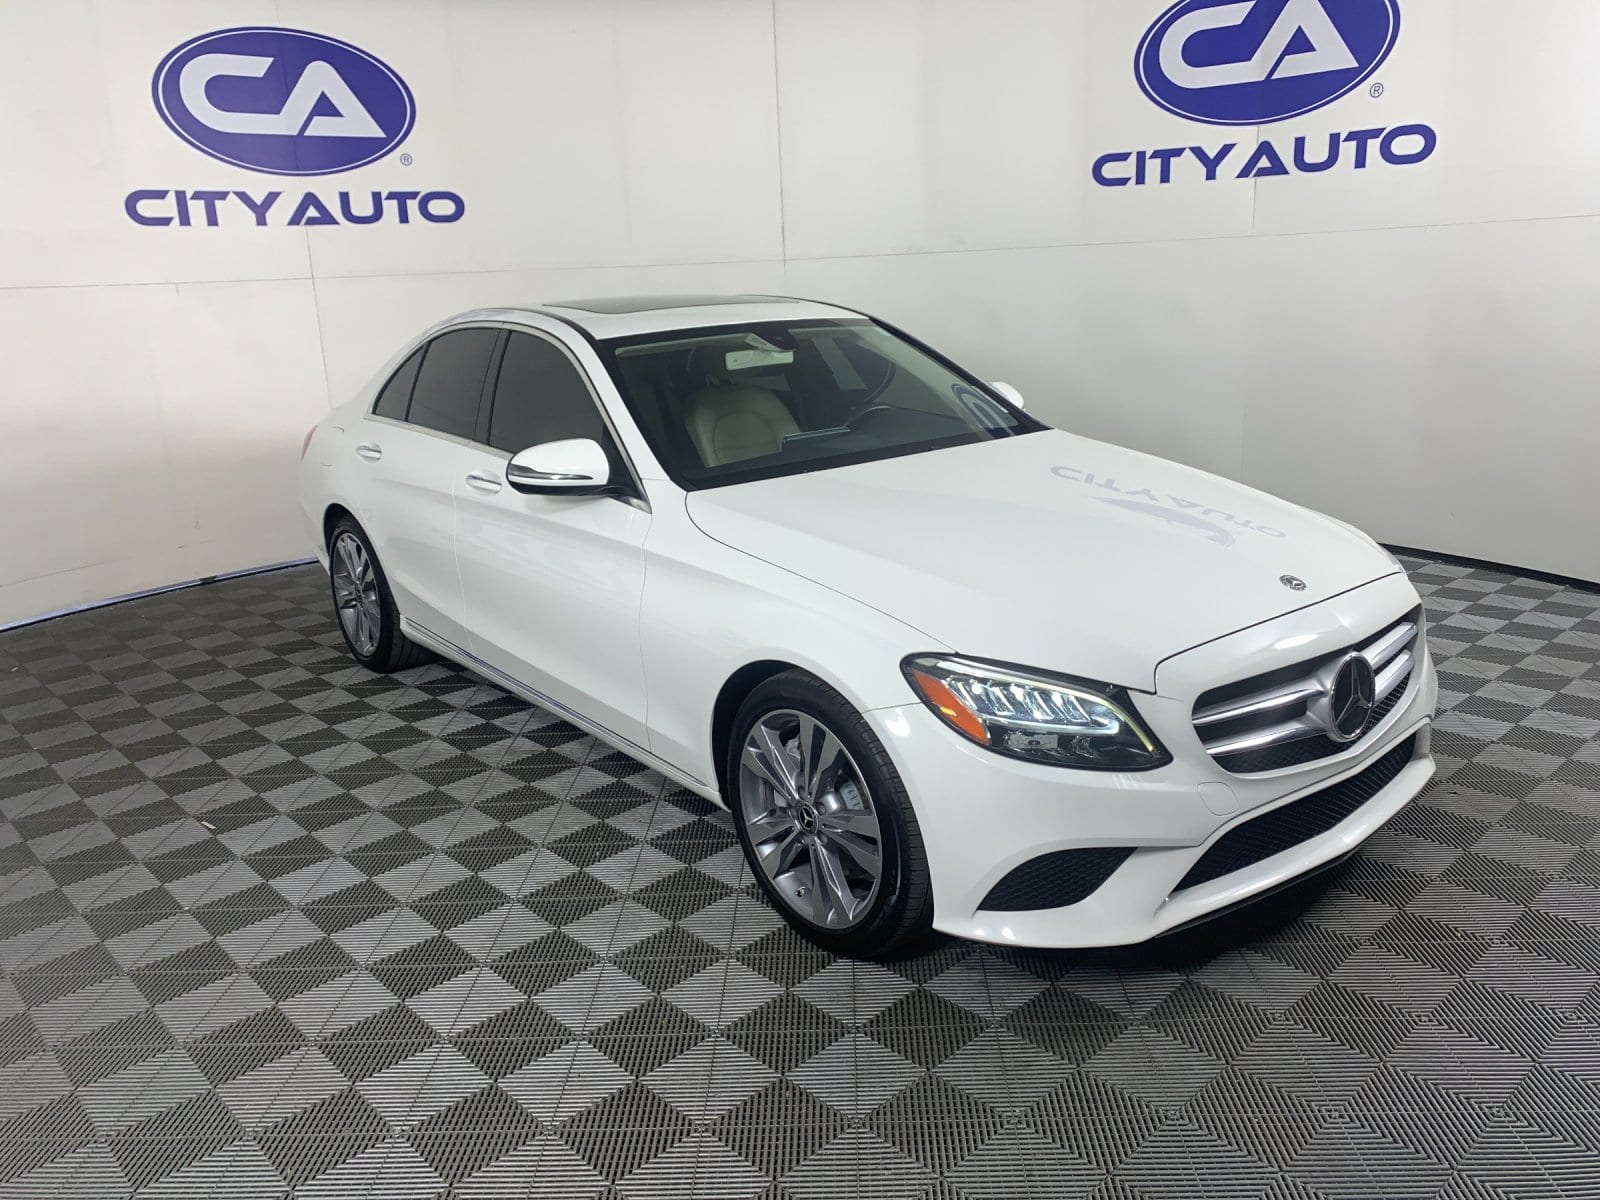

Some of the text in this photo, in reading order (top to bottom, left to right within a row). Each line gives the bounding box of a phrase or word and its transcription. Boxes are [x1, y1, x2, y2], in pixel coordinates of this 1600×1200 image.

[1159, 0, 1359, 89] CA
[179, 53, 387, 138] CA
[1092, 123, 1437, 187] CITY AUTO
[125, 189, 465, 226] CITY AUTO
